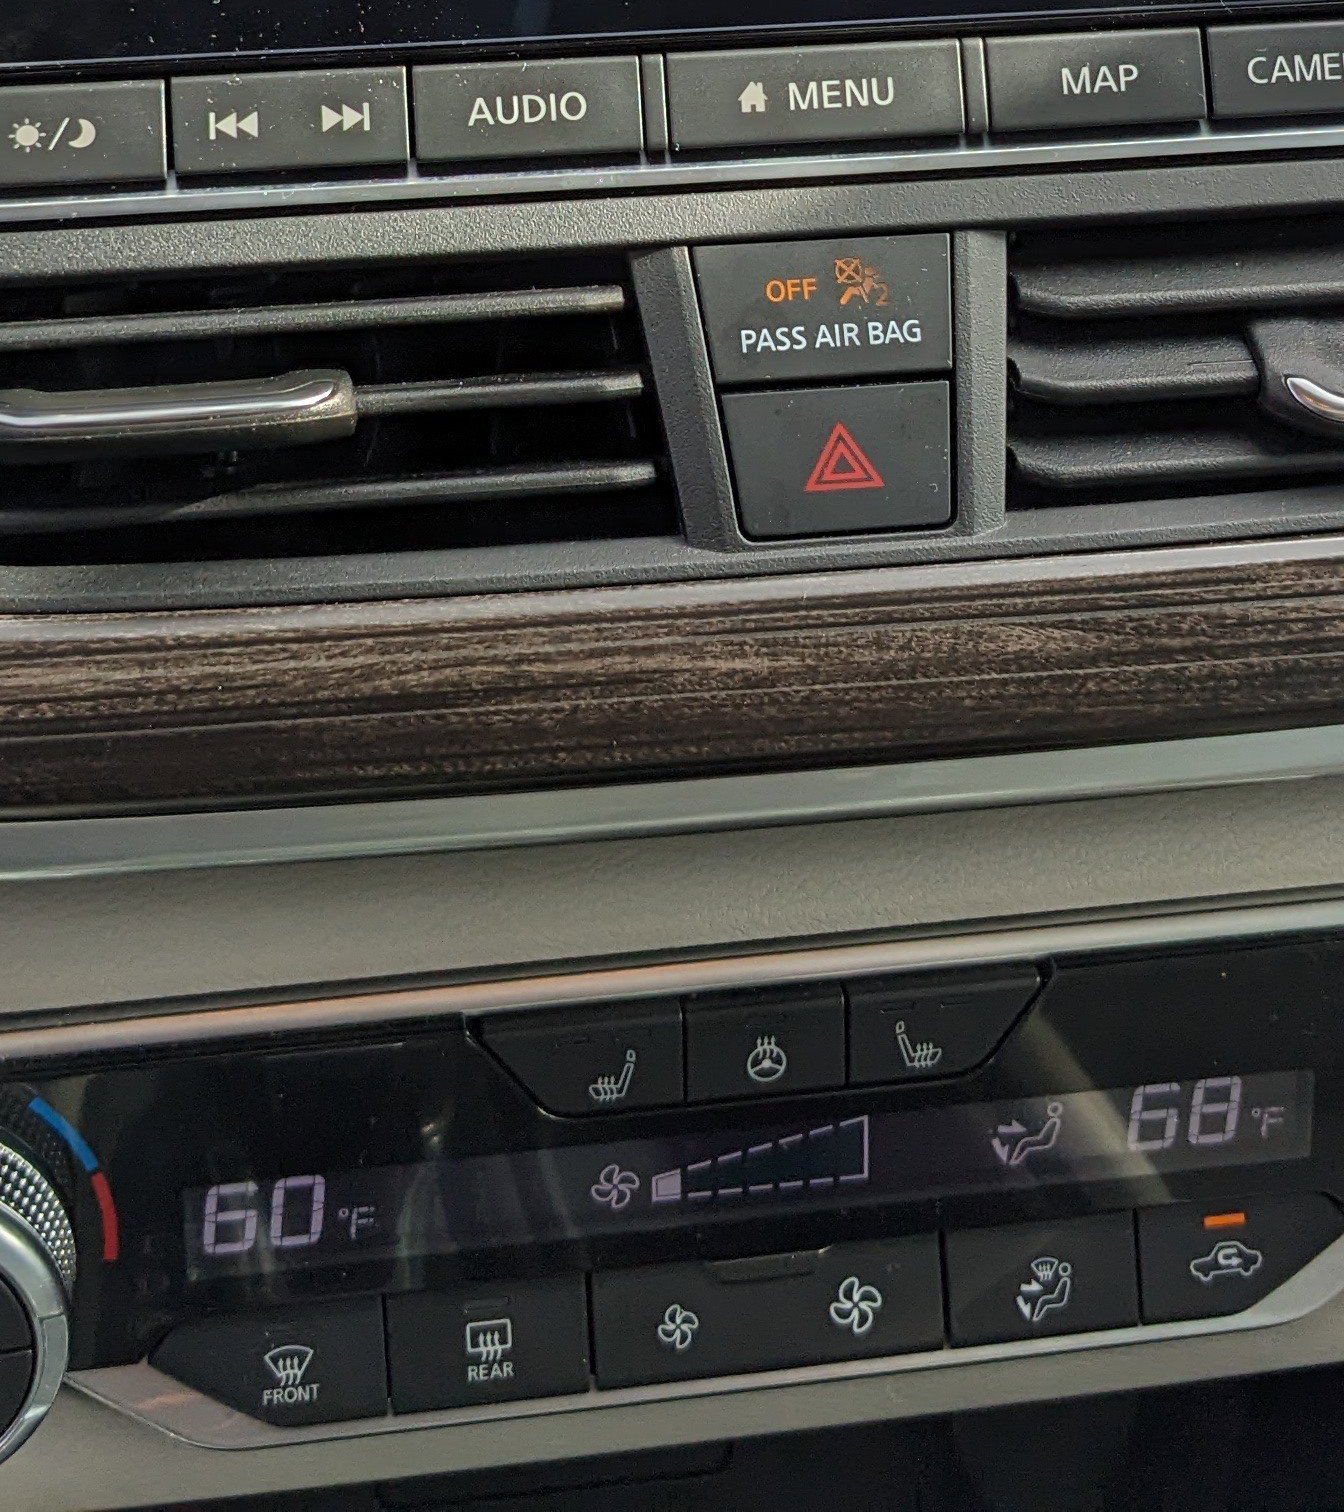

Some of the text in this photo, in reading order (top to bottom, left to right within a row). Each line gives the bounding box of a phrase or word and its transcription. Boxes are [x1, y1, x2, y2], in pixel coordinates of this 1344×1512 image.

[788, 76, 894, 110] MENU
[1061, 64, 1138, 94] MAP
[468, 91, 587, 126] AUDIO
[764, 279, 816, 303] OFF
[740, 319, 921, 353] PASS AIR BAG
[1127, 1075, 1242, 1152] 68
[203, 1175, 326, 1254] 60
[467, 1361, 514, 1381] REAR
[263, 1382, 320, 1406] FRONT
